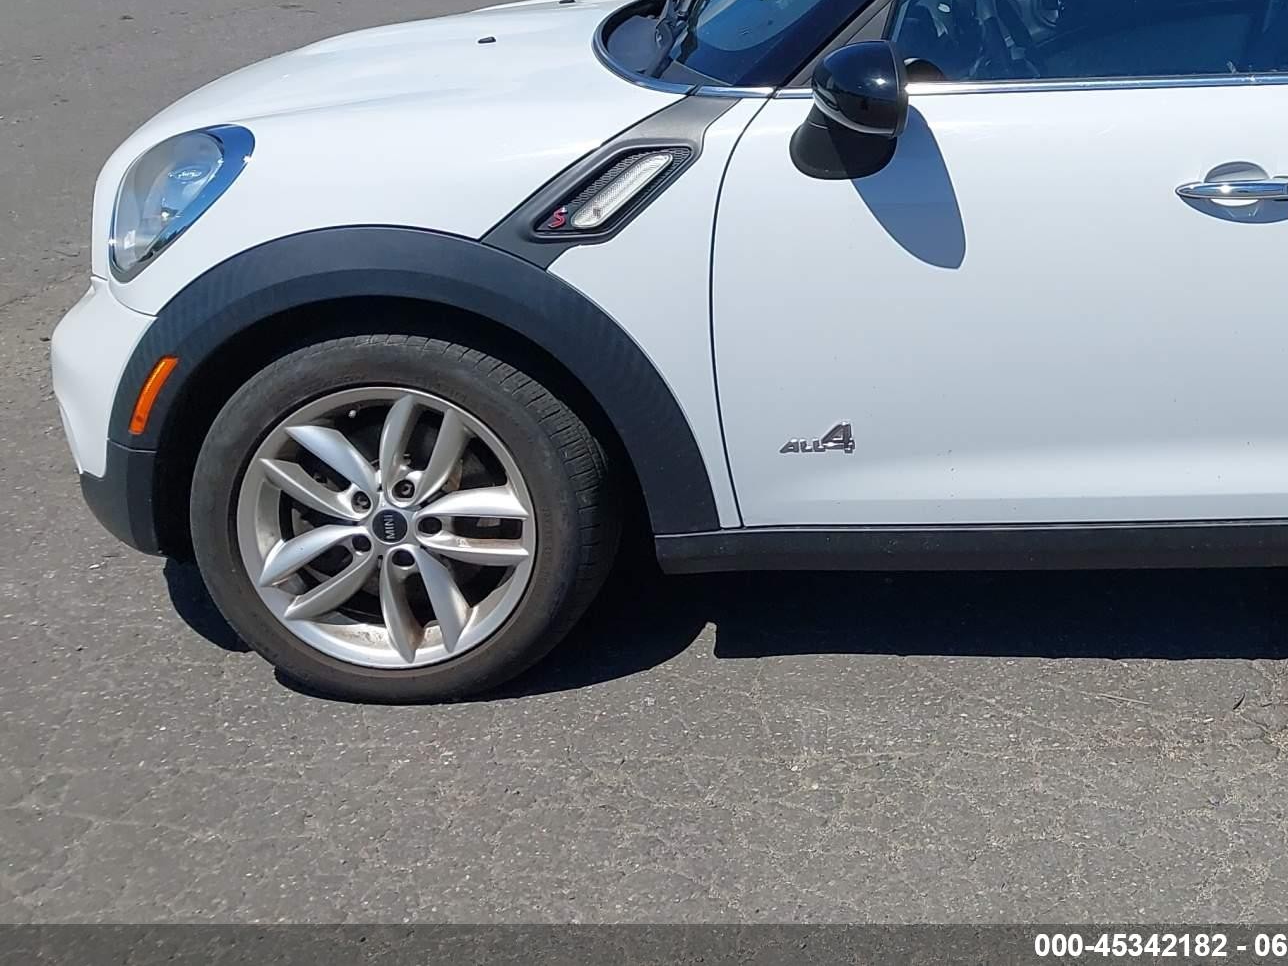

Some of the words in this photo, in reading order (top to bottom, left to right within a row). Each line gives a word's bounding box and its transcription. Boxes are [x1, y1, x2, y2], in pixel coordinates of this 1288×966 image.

[547, 206, 568, 229] S
[779, 420, 856, 454] ALL4
[383, 514, 396, 540] MINI
